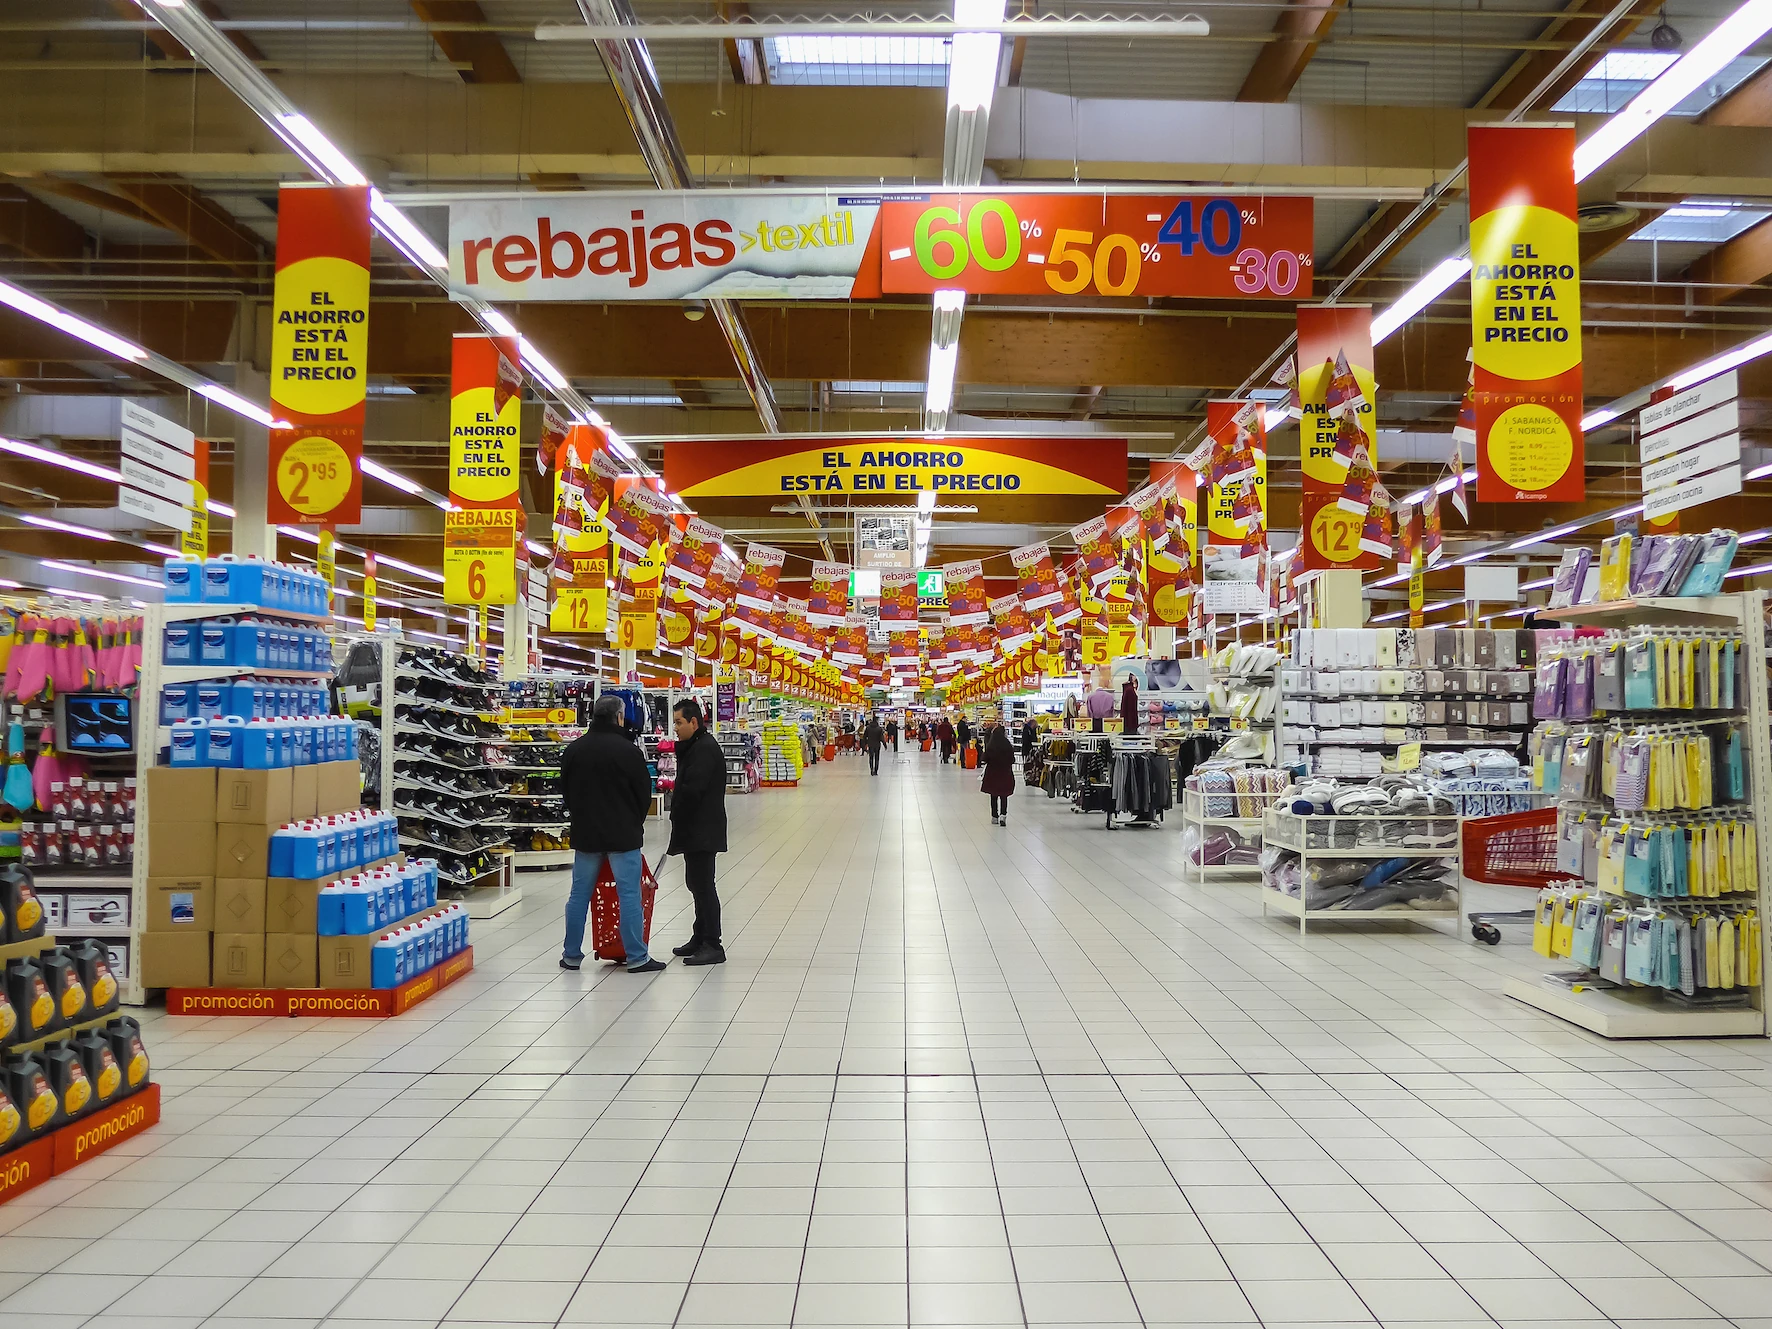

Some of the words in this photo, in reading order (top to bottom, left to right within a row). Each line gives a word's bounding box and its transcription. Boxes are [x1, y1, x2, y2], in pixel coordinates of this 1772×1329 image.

[462, 209, 736, 288] rebajas
[1510, 243, 1539, 259] EL
[1474, 265, 1574, 280] AHORRO
[1495, 281, 1556, 300] ESTÁ
[311, 292, 335, 306] EL
[278, 309, 365, 324] AHORRO
[1494, 306, 1526, 321] EN
[1532, 306, 1558, 321] EL
[295, 325, 348, 343] ESTÁ
[1484, 327, 1569, 342] PRECIO
[292, 348, 320, 362] EN
[325, 348, 349, 362] EL
[283, 366, 357, 381] PRECIO
[1483, 394, 1574, 405] promoción
[1644, 409, 1663, 425] tablas
[1664, 406, 1672, 417] de
[1672, 393, 1702, 418] planchar
[475, 413, 494, 422] EL
[545, 412, 569, 434] ebajas
[1512, 417, 1552, 425] SABANAS
[276, 428, 356, 438] promoción
[452, 426, 517, 436] AHORRO
[1518, 427, 1556, 435] NORDICA
[465, 437, 504, 449] ESTÁ
[1644, 436, 1670, 456] perchas
[463, 453, 483, 463] EN
[487, 453, 504, 463] EL
[822, 451, 851, 468] EL
[860, 451, 964, 468] AHORRO
[457, 467, 511, 477] PRECIO
[1646, 461, 1681, 483] ordenación
[1680, 454, 1701, 471] hogar
[780, 470, 843, 491] ESTÁ
[853, 474, 886, 490] EN
[894, 474, 923, 490] EL
[932, 474, 1021, 490] PRECIO
[637, 492, 671, 513] rebajas
[1133, 486, 1160, 508] rebajas
[1646, 492, 1681, 511] ordenación
[1682, 485, 1703, 500] cocina
[446, 511, 513, 525] REBAJAS
[583, 525, 602, 533] CIO
[689, 523, 722, 540] rebajas
[1075, 519, 1106, 541] rebajas
[748, 549, 783, 562] rebajas
[1014, 545, 1048, 564] rebajas
[576, 560, 605, 572] AJAS
[814, 566, 850, 577] rebajas
[946, 564, 981, 578] rebajas
[468, 559, 486, 600] 6
[882, 571, 917, 582] rebajas
[918, 597, 949, 606] PREC
[992, 597, 1018, 611] rebajas
[1108, 604, 1131, 612] REBA
[569, 597, 589, 629] 12
[1156, 608, 1173, 616] 9,99
[623, 620, 634, 647] 9
[1119, 631, 1137, 653] 7
[1092, 642, 1107, 662] 5
[718, 666, 733, 677] 3x2
[557, 710, 566, 722] 9
[1080, 722, 1086, 730] 5
[1110, 723, 1117, 731] 7
[405, 976, 433, 1007] promoción
[183, 992, 274, 1009] promoción
[288, 993, 380, 1011] promoción
[76, 1103, 144, 1160] promoción
